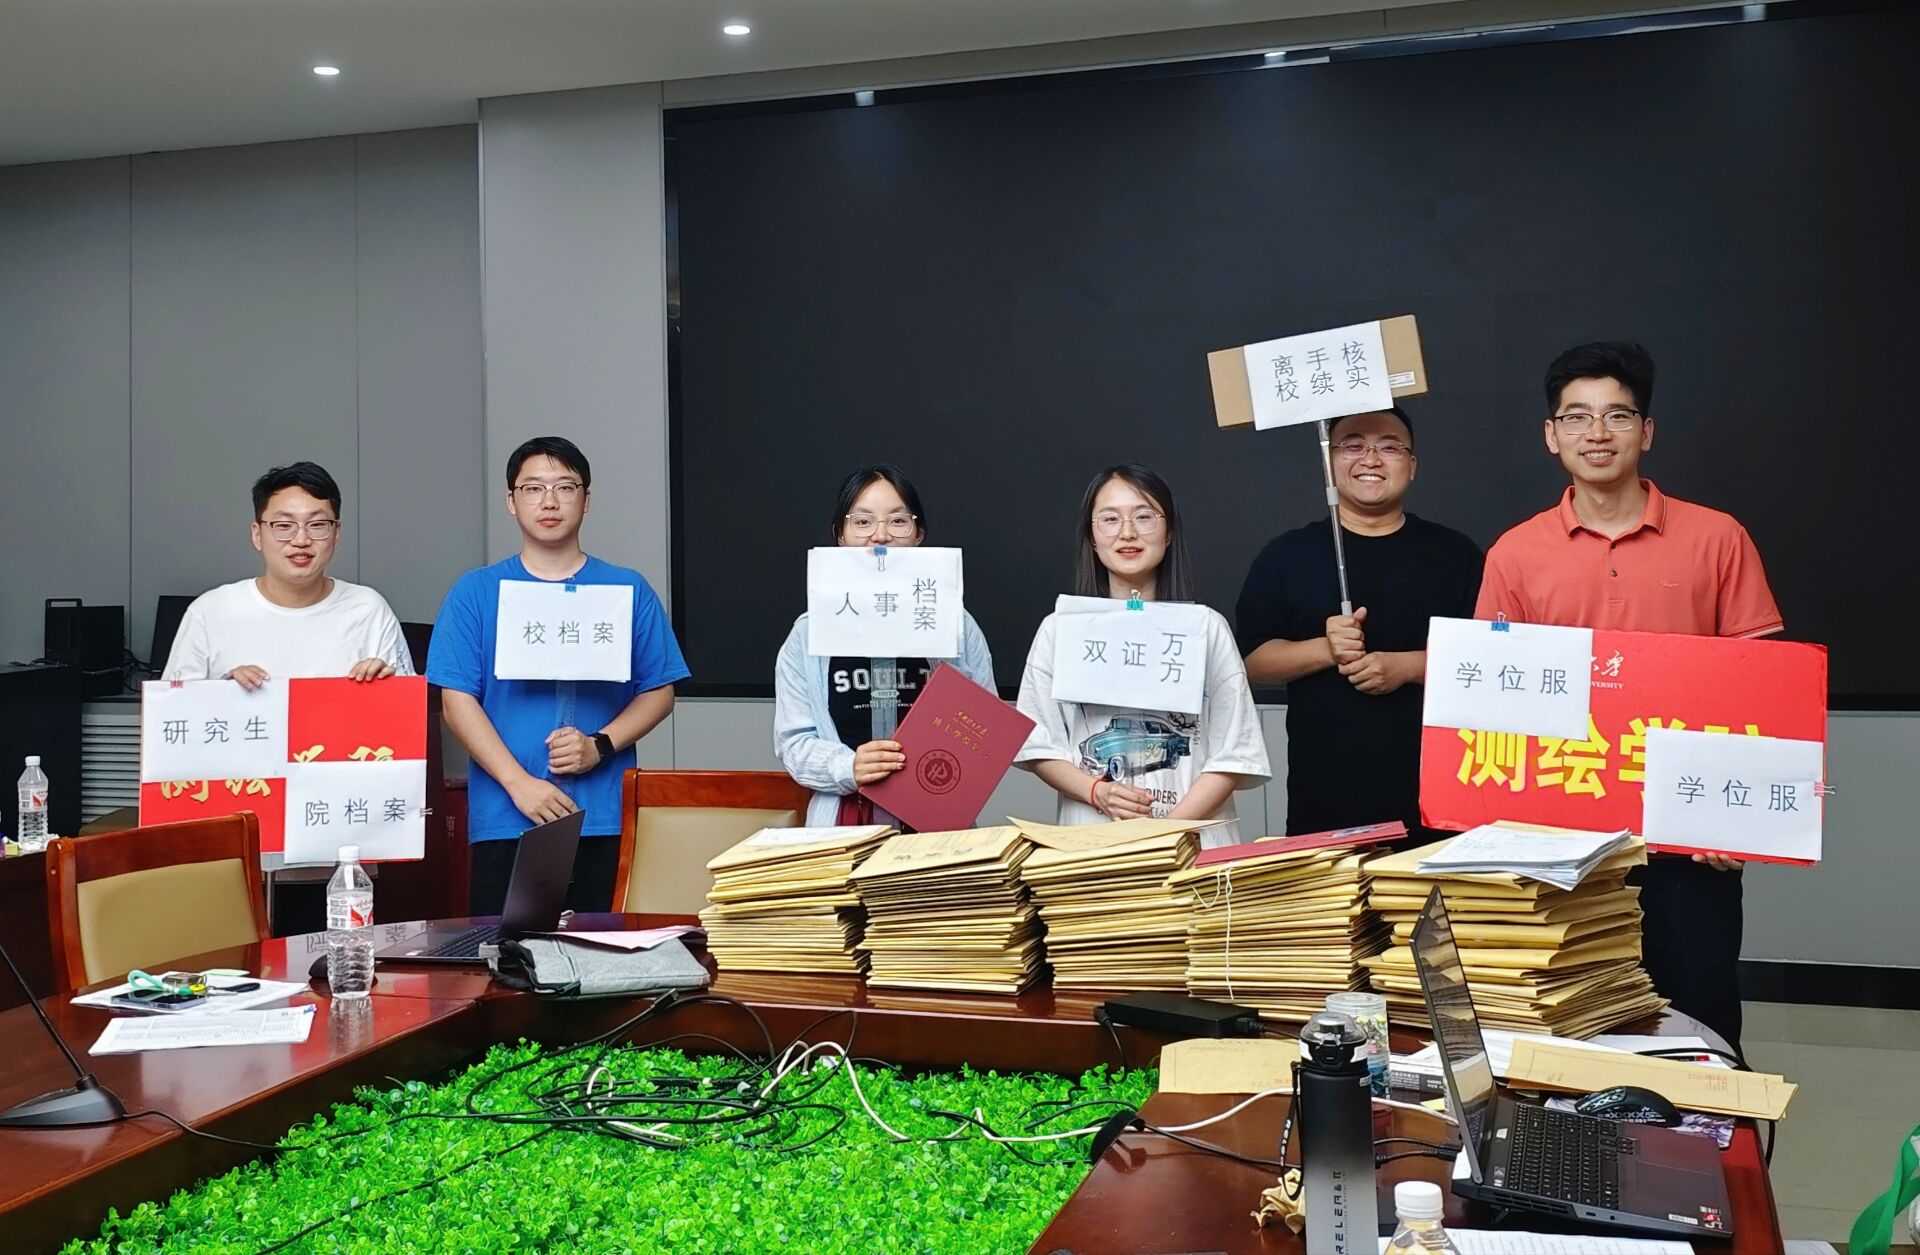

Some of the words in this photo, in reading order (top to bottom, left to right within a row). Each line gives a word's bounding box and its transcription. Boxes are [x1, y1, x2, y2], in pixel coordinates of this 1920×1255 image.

[523, 620, 614, 645] 校档案
[1456, 662, 1569, 695] 学位服
[162, 716, 269, 745] 研究生
[1456, 714, 1765, 800] 测绘
[1677, 776, 1799, 812] 学位服
[304, 798, 406, 827] 院档案
